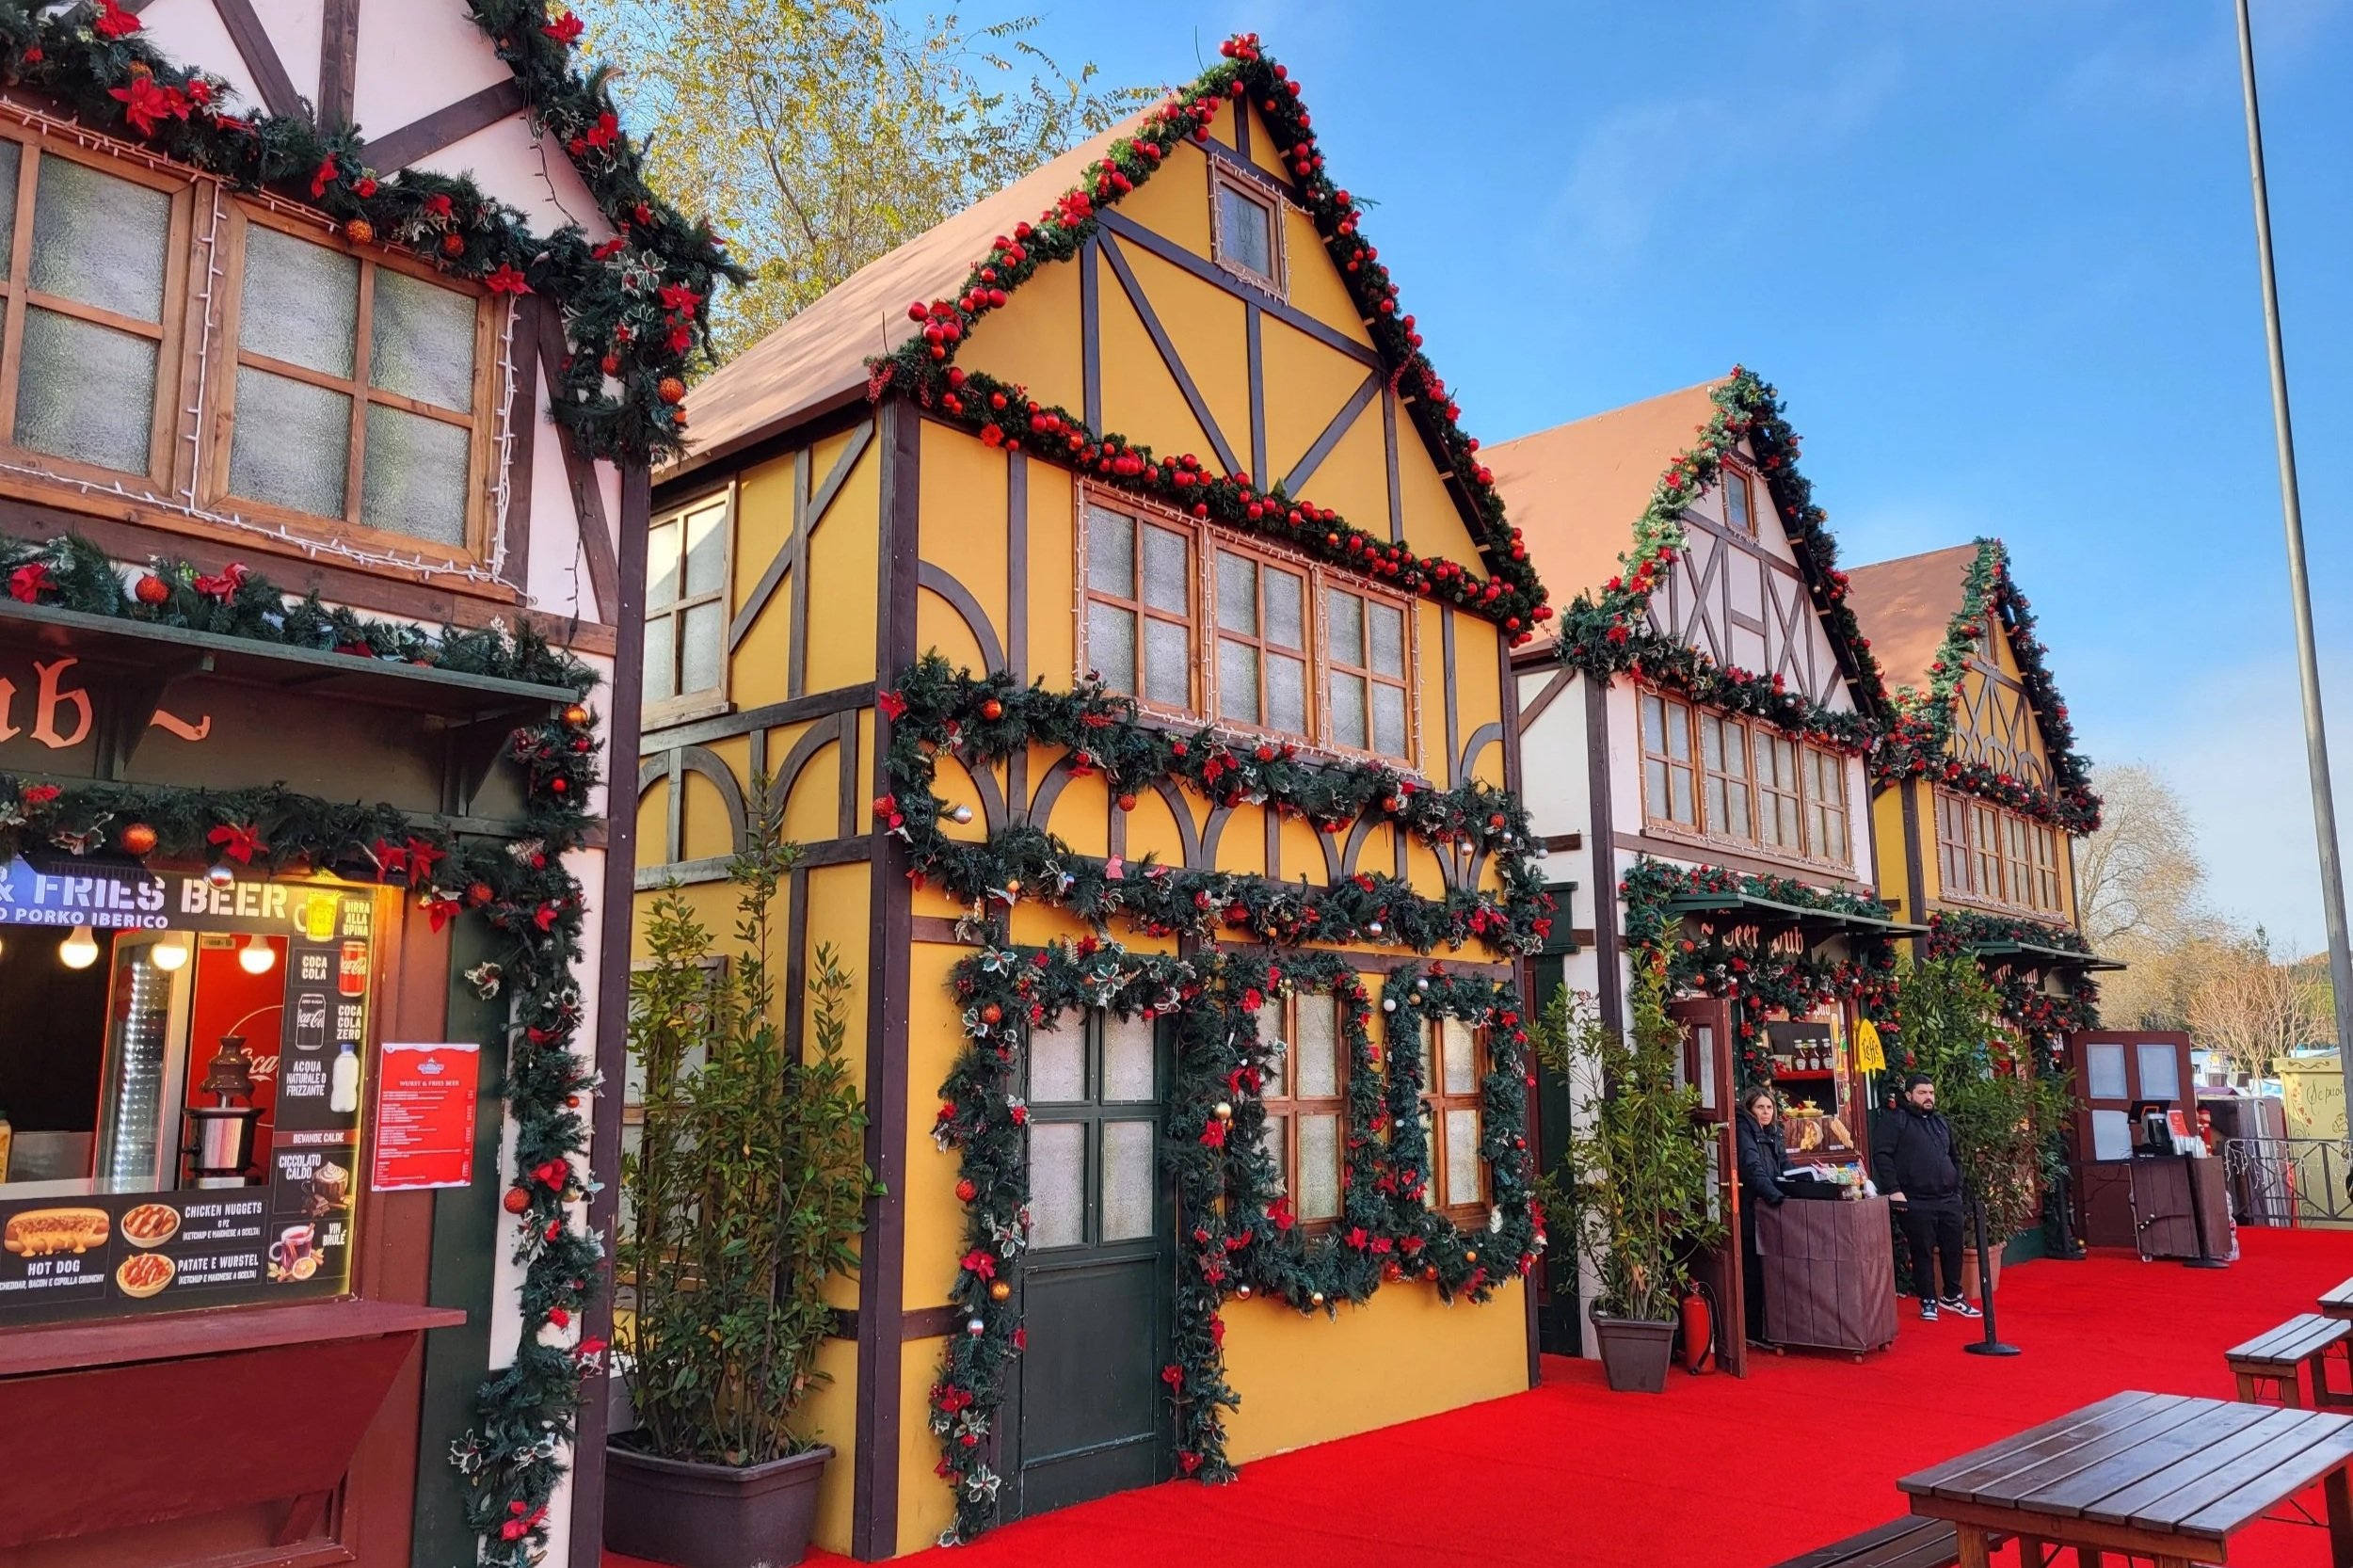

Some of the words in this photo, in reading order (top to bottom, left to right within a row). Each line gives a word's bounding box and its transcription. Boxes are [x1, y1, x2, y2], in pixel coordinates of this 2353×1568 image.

[34, 874, 166, 911] FRIES
[181, 878, 288, 919] BEER
[344, 900, 371, 914] BIRRA
[15, 907, 85, 924] PORKO
[91, 912, 168, 929] IBERICO
[345, 913, 368, 925] ALLA
[343, 924, 368, 936] SPINA
[302, 955, 328, 968] COCA
[301, 968, 327, 980] COLA
[339, 1004, 362, 1016] COCA
[338, 1016, 361, 1029] COLA
[336, 1029, 361, 1040] ZERO
[293, 1061, 322, 1073] ACQUA
[286, 1073, 319, 1085] NATURALE
[321, 1073, 327, 1084] O
[286, 1084, 326, 1097] FRIZZANTE
[293, 1132, 323, 1144] BEVANDE
[323, 1132, 344, 1143] CALDE
[279, 1154, 322, 1168] CICCOLATO
[286, 1167, 312, 1180] CALDO
[184, 1205, 222, 1219] CHICKEN
[224, 1202, 263, 1216] NUGGETS
[222, 1219, 231, 1228] PZ
[328, 1223, 342, 1234] VIN
[207, 1230, 212, 1239] E
[236, 1227, 241, 1236] A
[322, 1229, 347, 1246] BRULÉ
[27, 1261, 53, 1276] HOT
[56, 1259, 81, 1274] DOG
[178, 1257, 209, 1272] PATATE
[211, 1256, 217, 1270] E
[219, 1254, 259, 1269] WURSTEL
[28, 1278, 48, 1288] BACON
[48, 1277, 54, 1287] E
[54, 1276, 77, 1287] CIPOLLA
[78, 1273, 105, 1285] CRUNCHY
[232, 1271, 237, 1280] A
